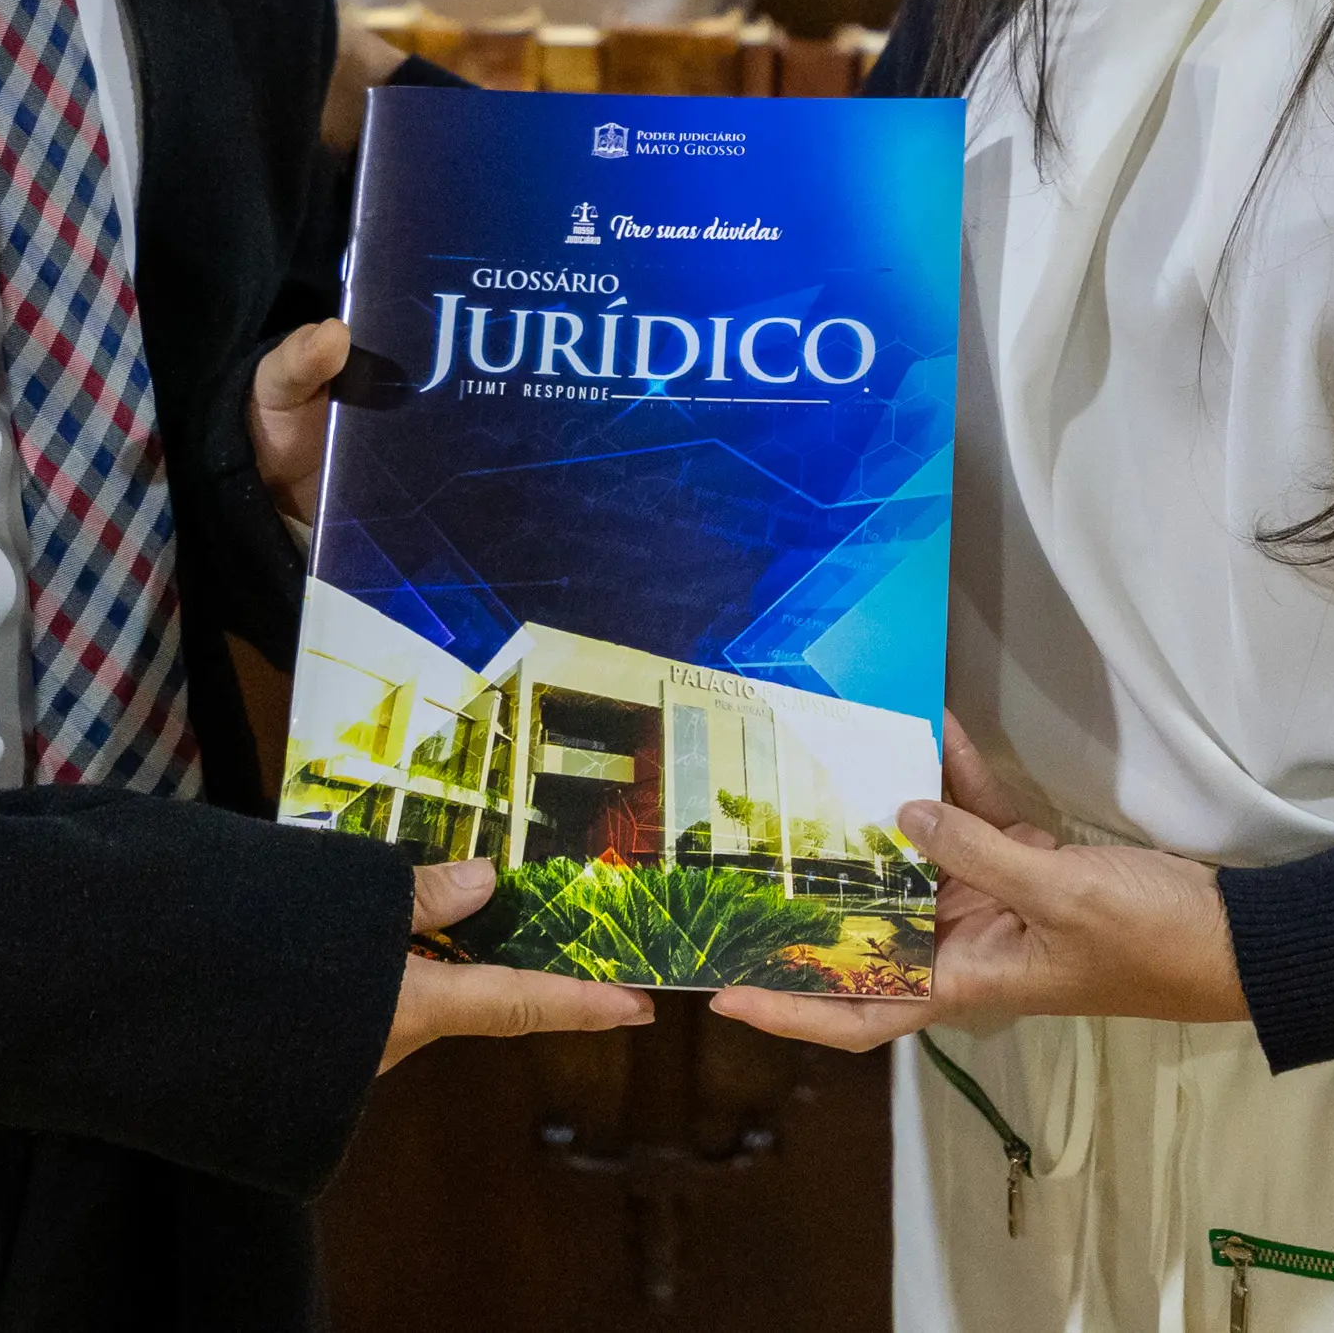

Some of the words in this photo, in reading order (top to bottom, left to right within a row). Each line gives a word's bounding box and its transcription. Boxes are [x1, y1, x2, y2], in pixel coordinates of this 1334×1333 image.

[636, 130, 676, 141] PODER
[679, 131, 746, 142] JUDICIÁRIO
[635, 143, 680, 156] MATO
[684, 143, 746, 157] GROSSO
[610, 215, 655, 240] Tire
[656, 224, 702, 240] suas
[703, 217, 783, 241] dúvidas
[472, 268, 620, 294] GLOSSÁRIO
[419, 293, 876, 393] JURÍDICO
[466, 380, 507, 396] TJMT
[523, 383, 610, 401] RESPONDE
